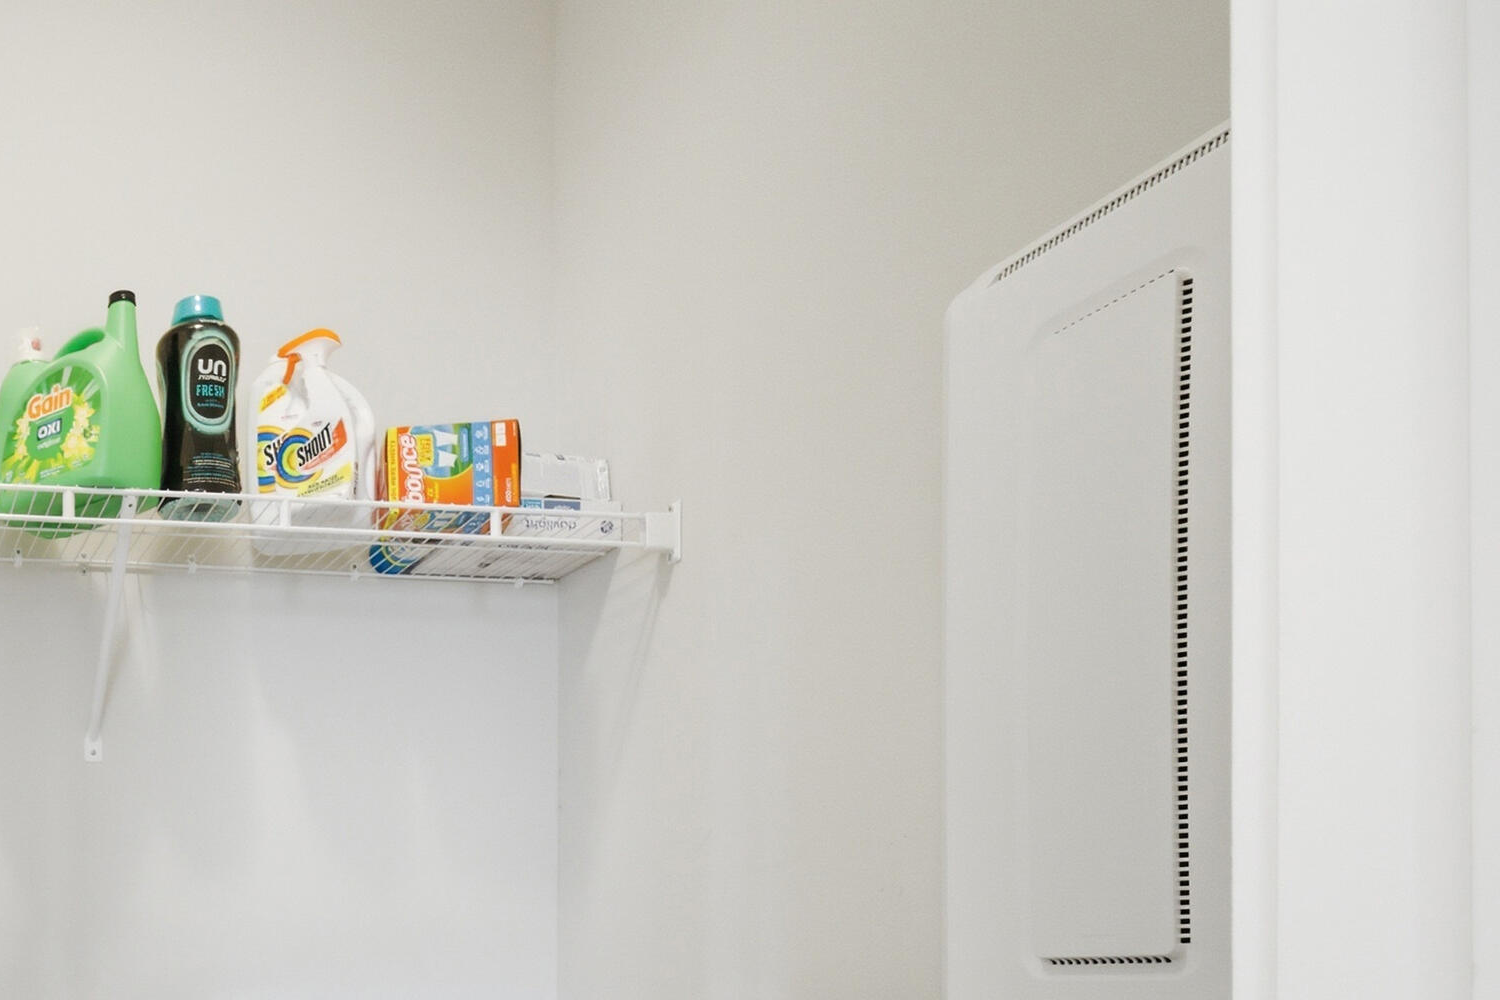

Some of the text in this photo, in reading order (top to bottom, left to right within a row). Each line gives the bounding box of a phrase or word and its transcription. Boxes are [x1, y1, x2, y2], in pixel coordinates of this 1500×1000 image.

[27, 384, 72, 420] Gain
[37, 419, 61, 440] OXI
[296, 422, 332, 467] SHOUT
